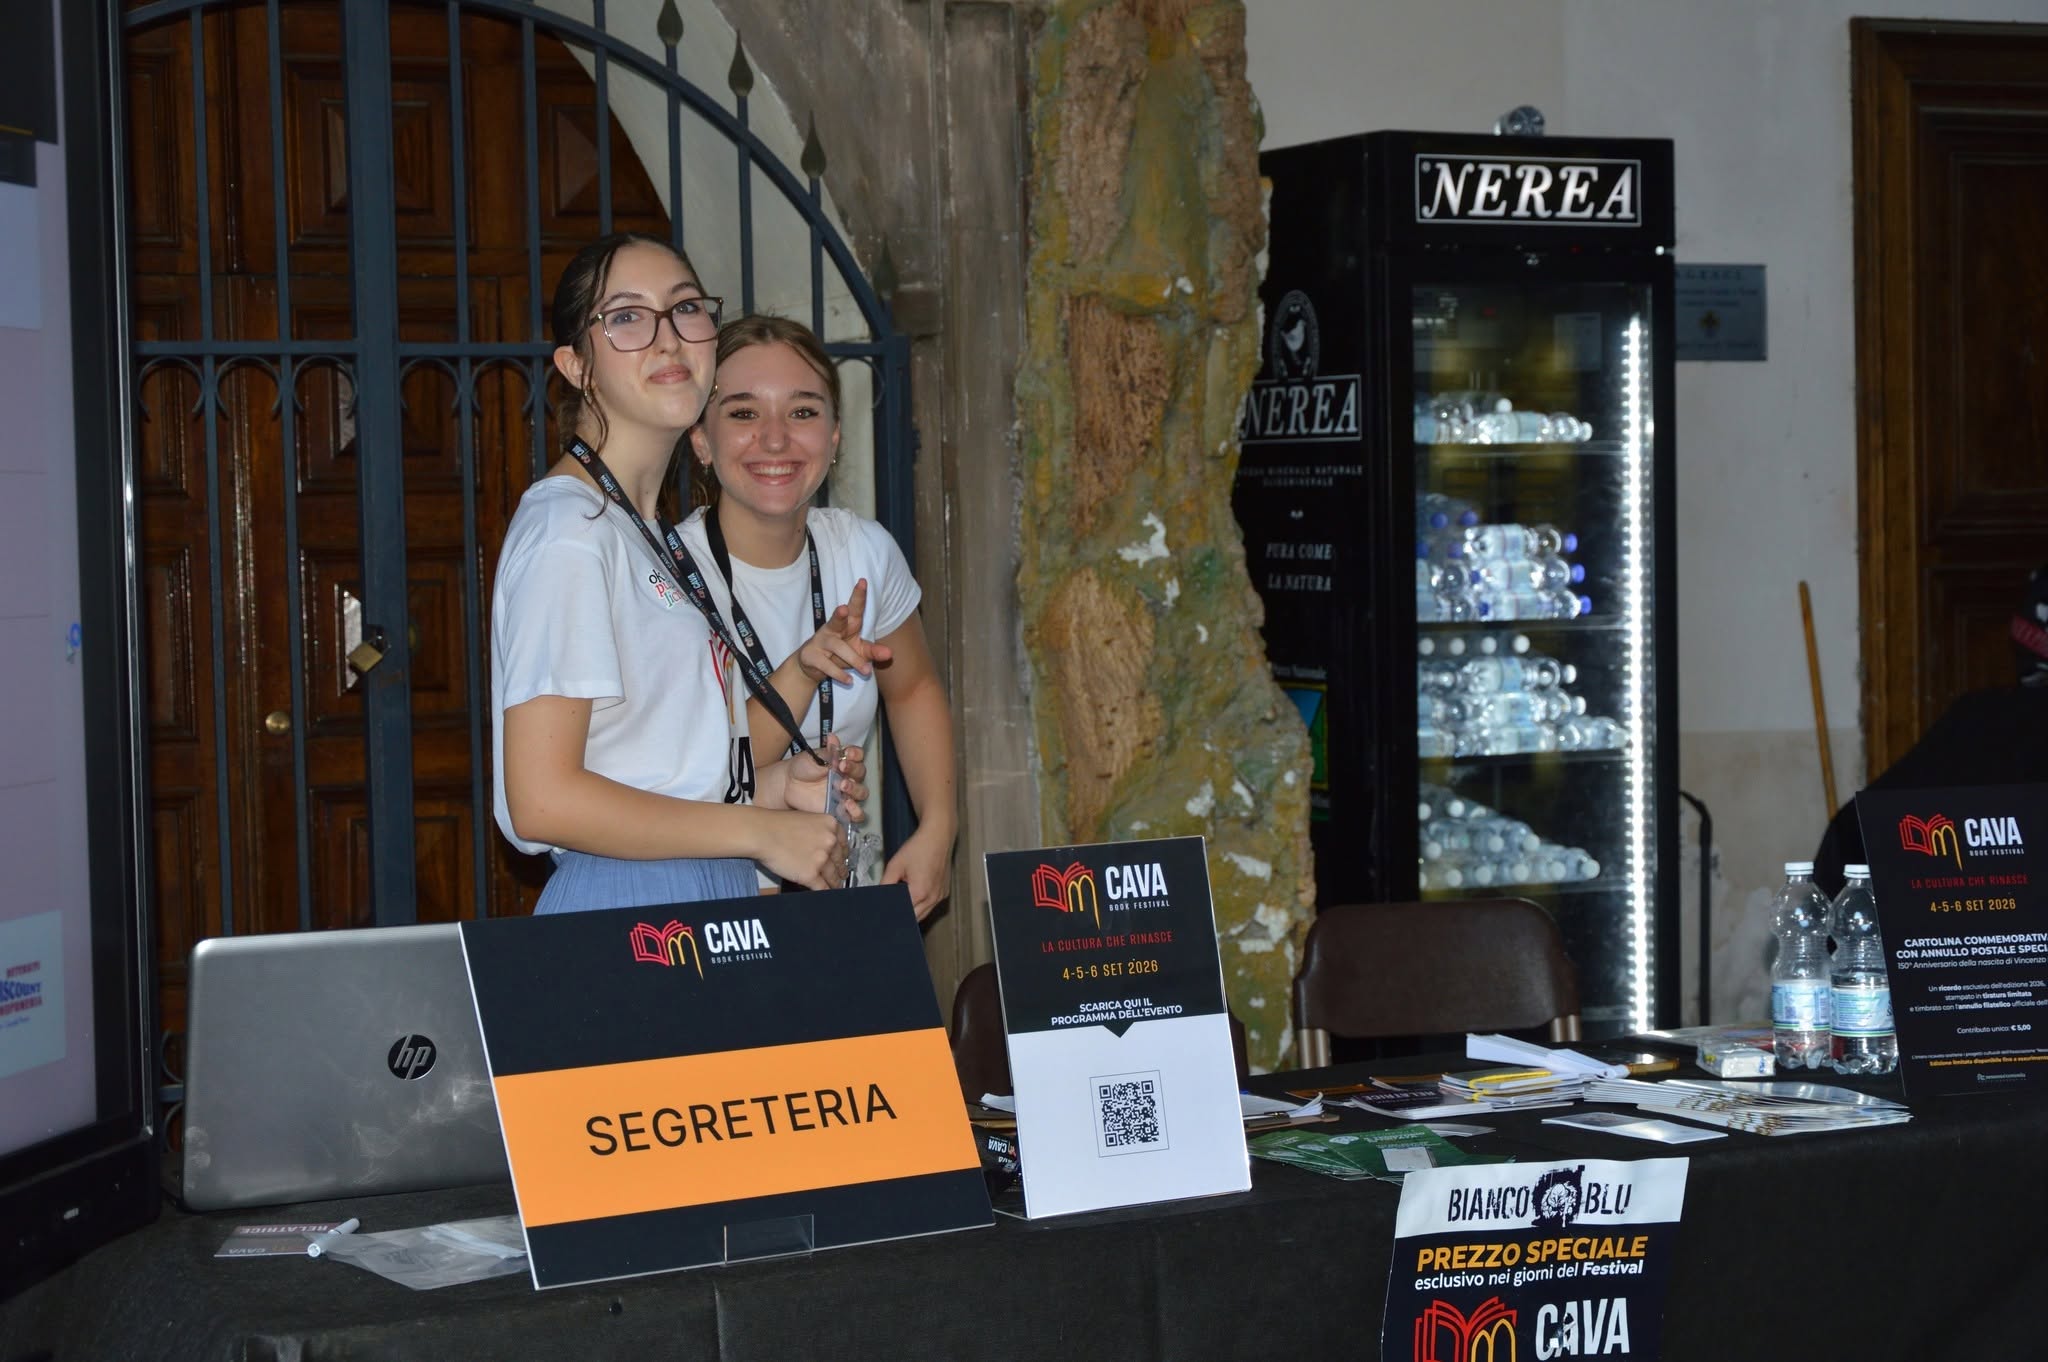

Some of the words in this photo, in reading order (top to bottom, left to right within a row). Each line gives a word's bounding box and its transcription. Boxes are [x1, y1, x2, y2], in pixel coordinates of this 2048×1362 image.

[1421, 162, 1636, 219] NEREA
[1240, 382, 1359, 437] NEREA
[1265, 543, 1295, 559] PURA
[1298, 544, 1333, 560] COME
[649, 569, 666, 584] ok
[1267, 573, 1282, 589] LA
[1284, 574, 1332, 592] NATURA
[1964, 817, 2023, 847] CAVA
[1105, 863, 1168, 900] CAVA
[1911, 879, 1922, 889] LA
[1925, 878, 1965, 889] CULTURA
[1968, 876, 1986, 887] CHE
[1990, 874, 2028, 886] RINASCE
[1109, 903, 1130, 912] BOOK
[1133, 900, 1170, 910] FESTIVAL
[1930, 900, 1962, 913] 4-5-6
[1966, 899, 1984, 912] SET
[1988, 898, 2016, 910] 2026
[704, 918, 770, 954] CAVA
[1042, 941, 1054, 953] LA
[1058, 936, 1102, 952] CULTURA
[1106, 934, 1126, 947] CHE
[1130, 930, 1173, 945] RINASCE
[1904, 937, 1962, 948] CARTOLINA
[1964, 932, 2048, 946] COMMEMORATIV
[711, 956, 732, 965] BOOK
[736, 952, 773, 962] FESTIVAL
[1896, 950, 1918, 959] CON
[1920, 947, 1969, 958] ANNULLO
[1971, 945, 2017, 956] POSTALE
[2018, 943, 2048, 954] SPECI
[1063, 964, 1098, 981] 4-5-6
[1104, 962, 1123, 977] SET
[1128, 960, 1159, 975] 2026
[1913, 959, 1958, 969] Anniversario
[1958, 958, 1976, 968] della
[2005, 957, 2013, 966] di
[1052, 1012, 1116, 1026] PROGRAMMA
[1118, 1004, 1182, 1020] DELL'EVENTO
[1080, 1000, 1122, 1012] SCARICA
[1123, 998, 1142, 1012] QUI
[1144, 998, 1152, 1007] IL
[391, 1034, 434, 1080] hp
[586, 1083, 898, 1156] SEGRETERIA
[1448, 1185, 1530, 1222] BIANCO
[1584, 1182, 1633, 1215] BLU
[1417, 1242, 1521, 1272] PREZZO
[1526, 1236, 1649, 1264] SPECIALE
[1415, 1273, 1484, 1291] esclusivo
[1488, 1269, 1510, 1286] nei
[1514, 1264, 1554, 1288] giorni
[1557, 1262, 1579, 1278] del
[1582, 1259, 1644, 1277] Festival
[1535, 1296, 1630, 1361] CAVA
